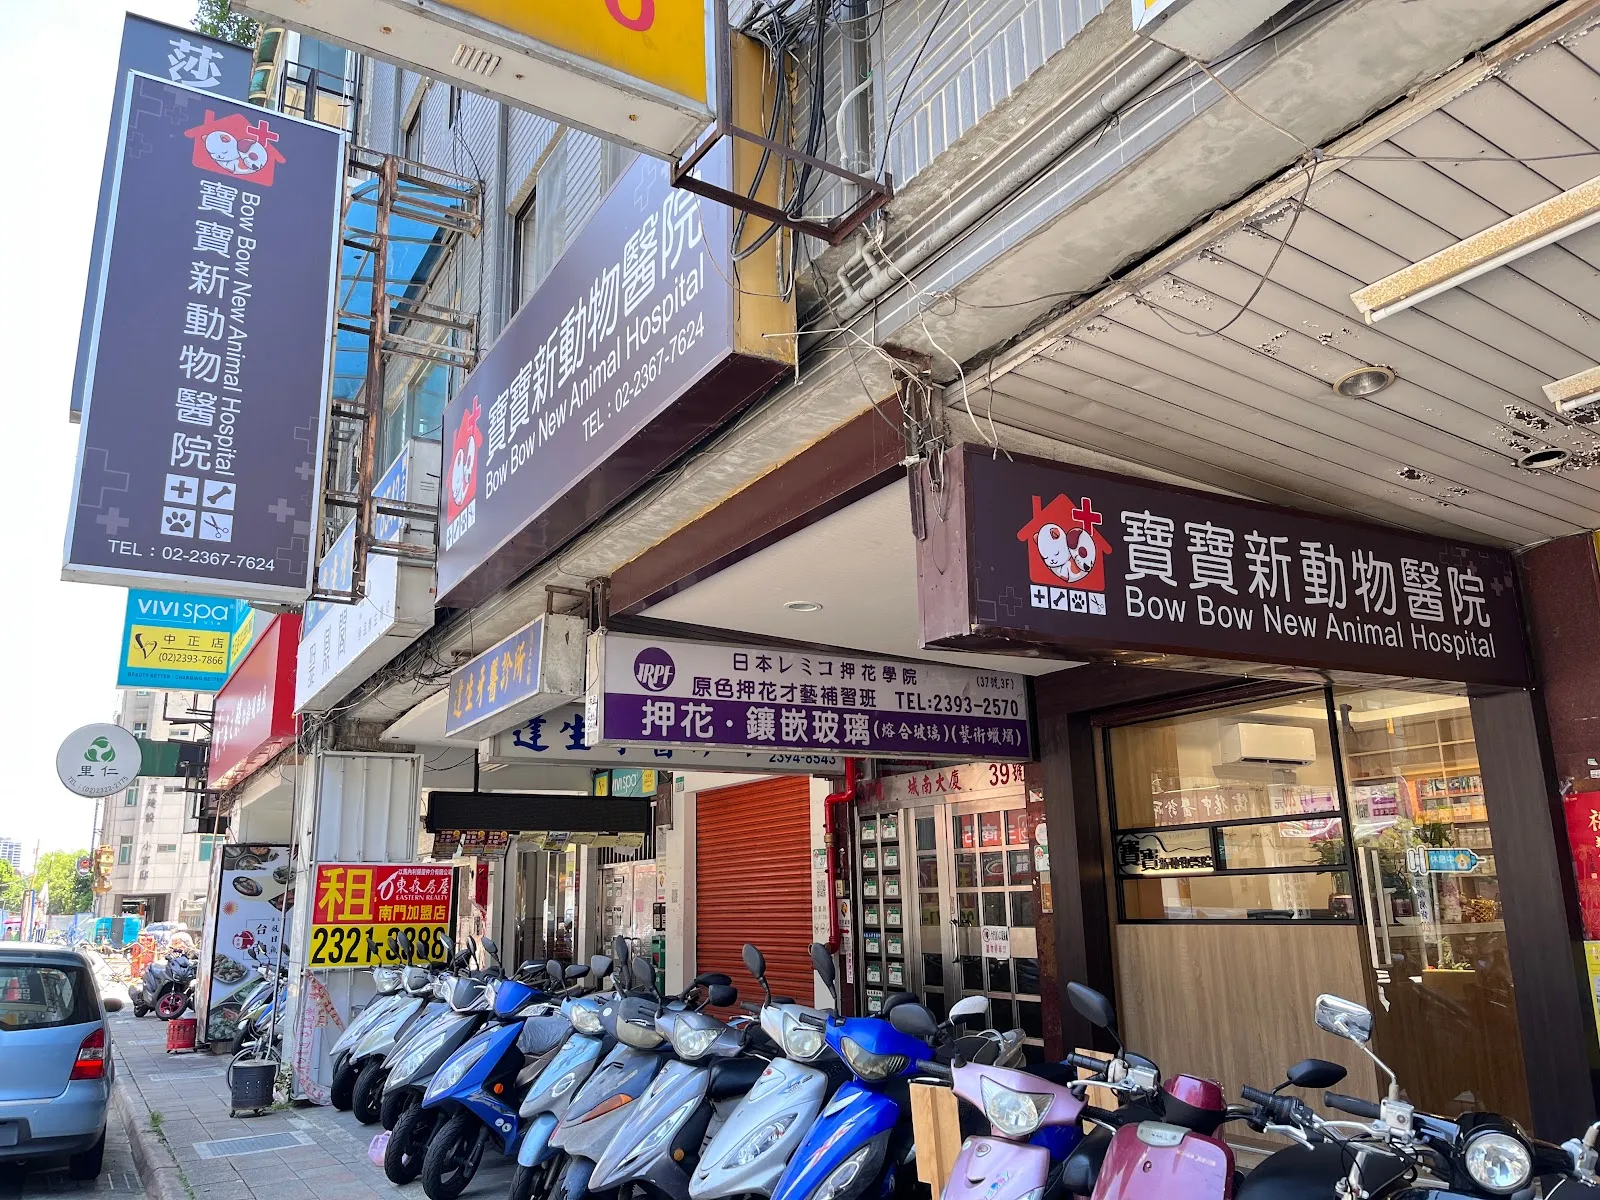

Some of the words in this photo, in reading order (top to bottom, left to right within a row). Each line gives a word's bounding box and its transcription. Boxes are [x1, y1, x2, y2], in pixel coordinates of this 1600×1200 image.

[168, 38, 224, 89] 莎
[239, 191, 260, 232] Bow
[233, 237, 257, 276] Bow
[230, 280, 253, 324] New
[486, 174, 703, 466] 寶寶新動物醫院
[170, 179, 238, 471] 寶寶新動物醫院
[222, 325, 248, 393] Animal
[485, 460, 509, 500] Bow
[510, 433, 536, 476] Bow
[538, 403, 567, 448] New
[570, 336, 621, 416] Animal
[627, 252, 705, 361] Hospital
[615, 311, 705, 413] 02-2367-7624
[214, 397, 242, 477] Hospital
[162, 545, 275, 573] 02-2367-7624
[1120, 510, 1491, 628] 寶寶新動物醫院
[137, 598, 180, 617] VIVI
[183, 602, 229, 624] spa
[1125, 586, 1186, 624] Bow
[1198, 594, 1254, 631] Bow
[1264, 603, 1317, 639] New
[1325, 611, 1405, 648] Animal
[1411, 622, 1497, 662] Hospital
[158, 652, 224, 666] (02)2393-7866
[163, 634, 224, 649] 中正店
[733, 653, 917, 686] 日本レミコ押花學院
[895, 691, 1019, 717] TEL:2393-2570
[77, 766, 119, 777] 里仁
[318, 867, 373, 922] 租
[395, 876, 450, 895] 東森房屋
[378, 904, 446, 921] 南門加盟店
